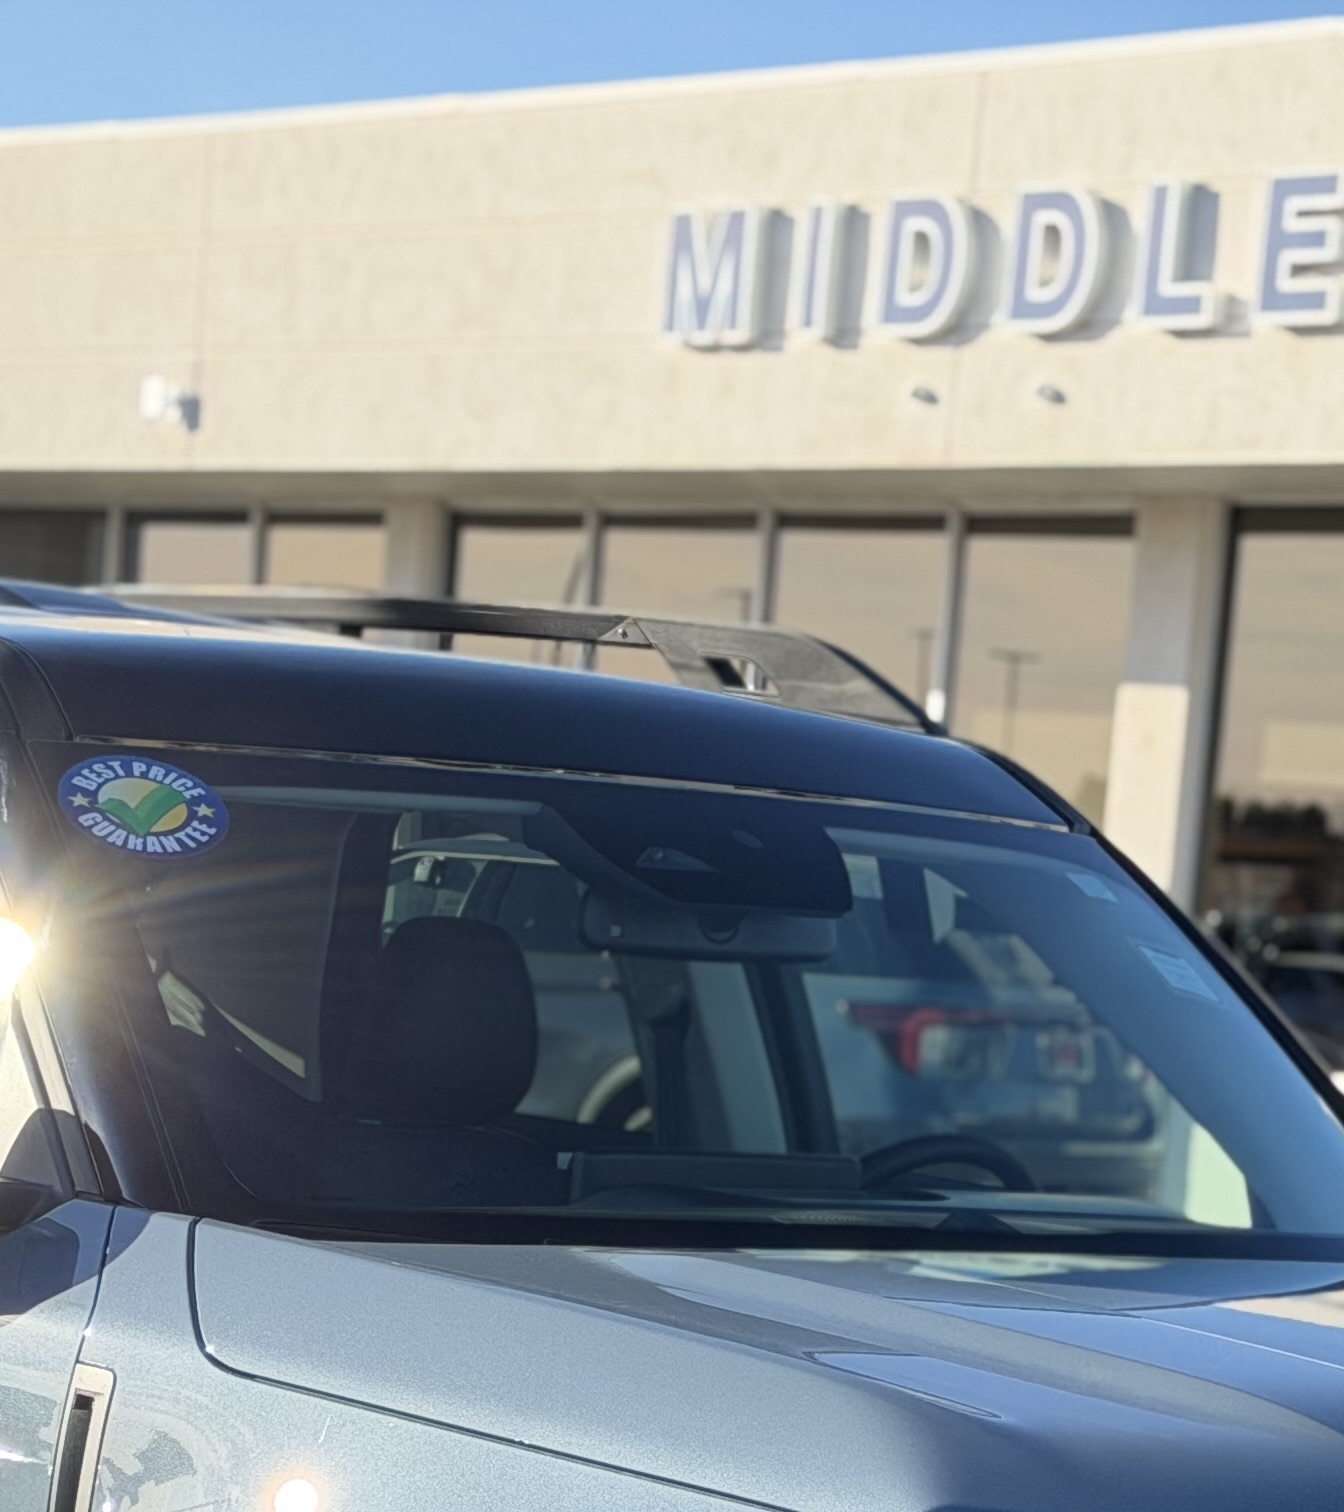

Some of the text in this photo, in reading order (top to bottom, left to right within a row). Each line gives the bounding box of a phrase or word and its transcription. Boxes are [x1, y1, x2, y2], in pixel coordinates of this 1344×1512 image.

[71, 761, 206, 800] BEST PRICE
[77, 811, 218, 853] GUARANTEE
